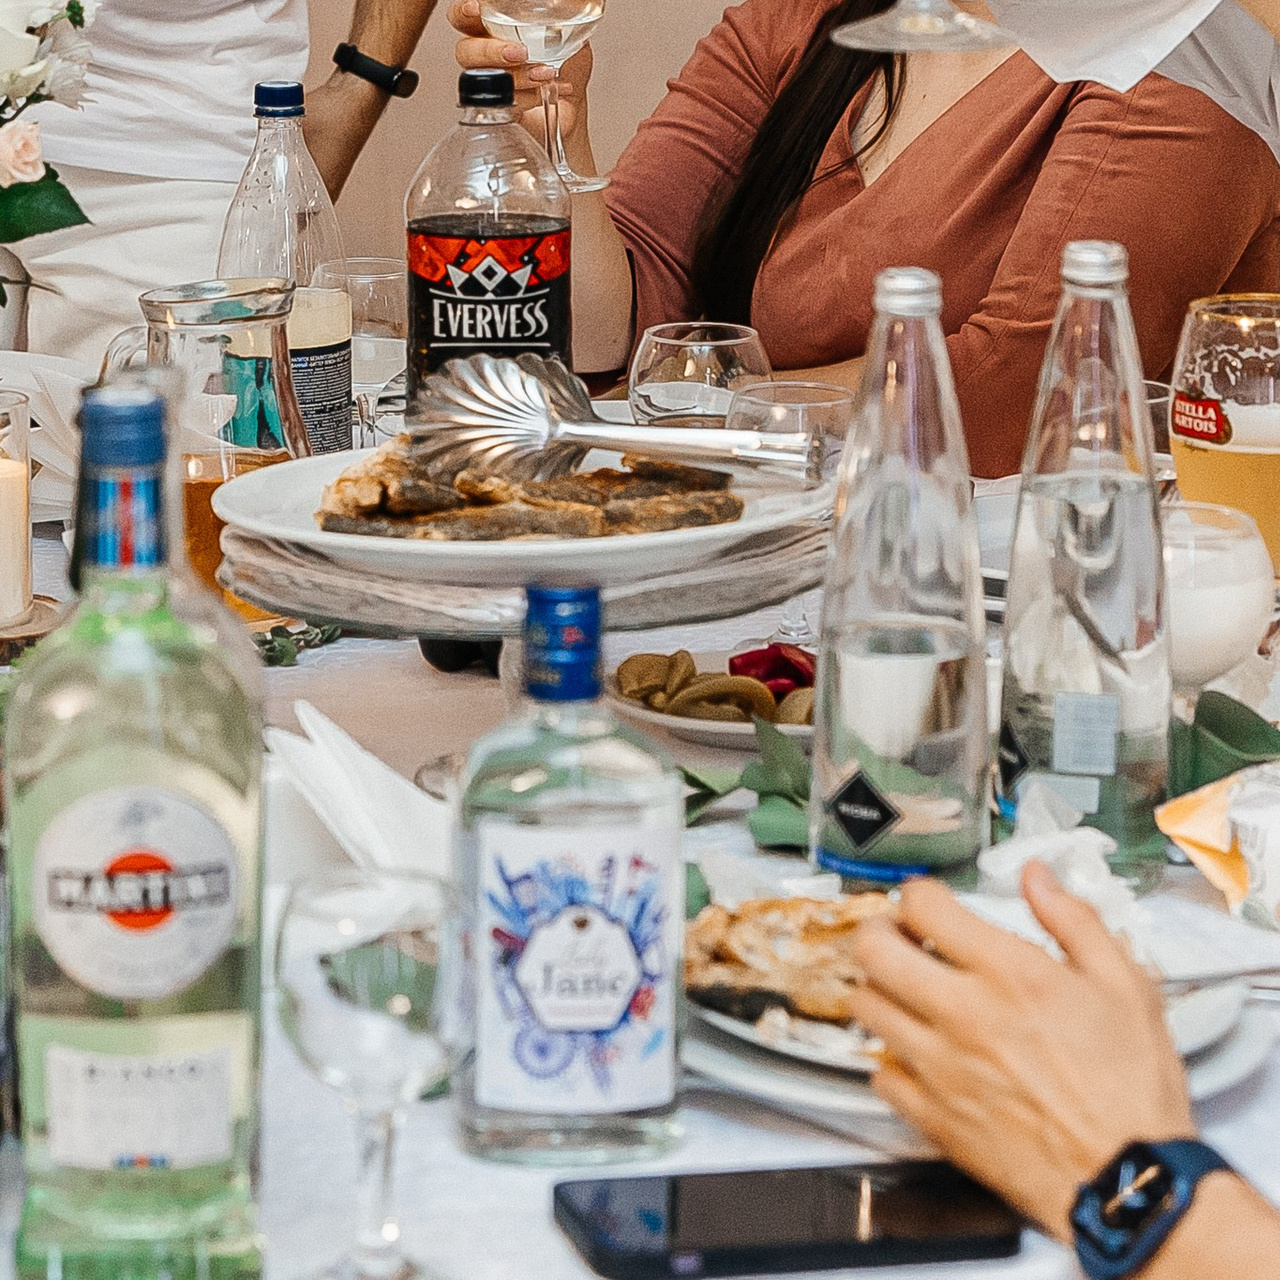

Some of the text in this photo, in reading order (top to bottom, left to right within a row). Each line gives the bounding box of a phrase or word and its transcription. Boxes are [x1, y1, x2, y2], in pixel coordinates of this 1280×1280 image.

[432, 298, 549, 339] EVERVESS
[1175, 400, 1217, 421] STELLA
[1175, 412, 1217, 434] ARTOIS
